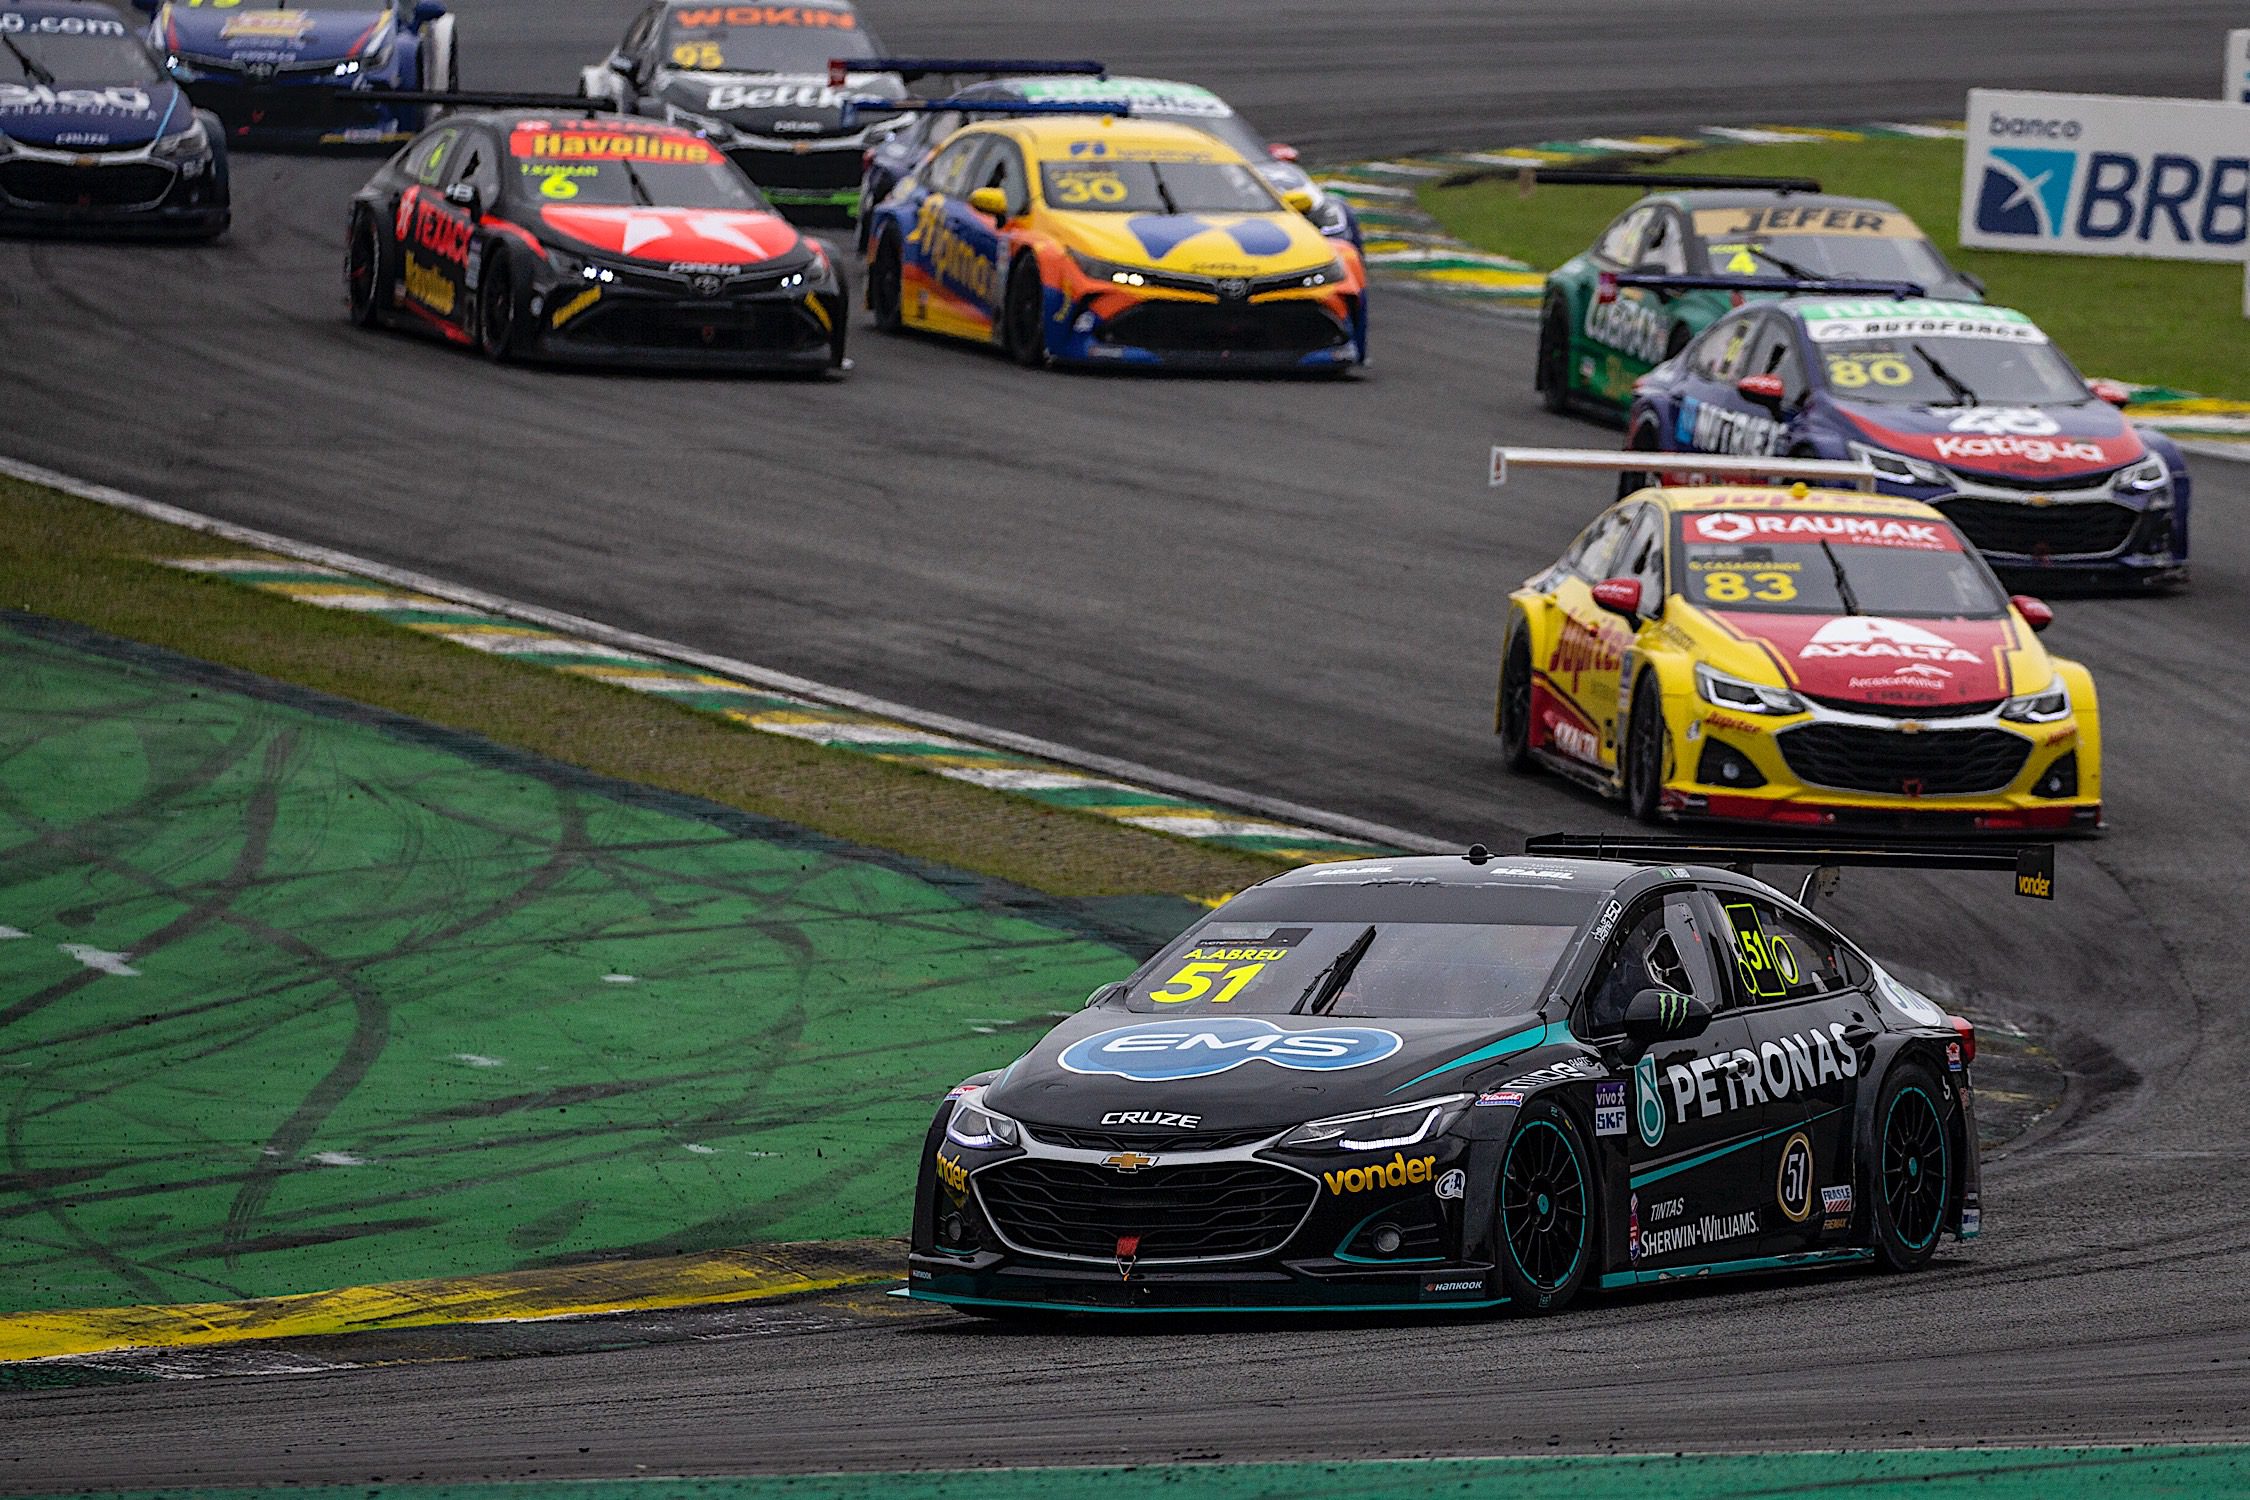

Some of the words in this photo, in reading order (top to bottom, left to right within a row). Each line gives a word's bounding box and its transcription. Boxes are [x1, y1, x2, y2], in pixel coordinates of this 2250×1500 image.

[677, 7, 856, 29] WOKIN
[1988, 112, 2081, 139] banco
[534, 133, 710, 164] Havoline
[540, 175, 579, 199] 6
[1056, 177, 1128, 204] 30
[2076, 151, 2250, 244] BRB
[1729, 208, 1884, 233] JEFER
[1726, 252, 1758, 276] 4
[1865, 323, 2032, 338] AUTOFORCE
[1829, 359, 1913, 388] 80
[1933, 435, 2106, 463] Katigua
[1753, 515, 1942, 542] RAUMAK
[1704, 572, 1798, 602] 83
[1799, 643, 1983, 664] AXALTA
[2018, 871, 2051, 896] vonder
[1183, 949, 1288, 960] A.ABREU
[1740, 930, 1772, 971] 51
[1150, 962, 1266, 1003] 51
[1102, 1033, 1359, 1057] EMS
[1568, 1056, 1594, 1068] PARTS
[1667, 1022, 1858, 1123] PETRONAS
[1596, 1088, 1617, 1105] vivo
[1101, 1111, 1202, 1129] CRUZE
[1597, 1111, 1626, 1130] SKF
[1786, 1153, 1806, 1202] 51
[1650, 1197, 1684, 1222] TINTAS
